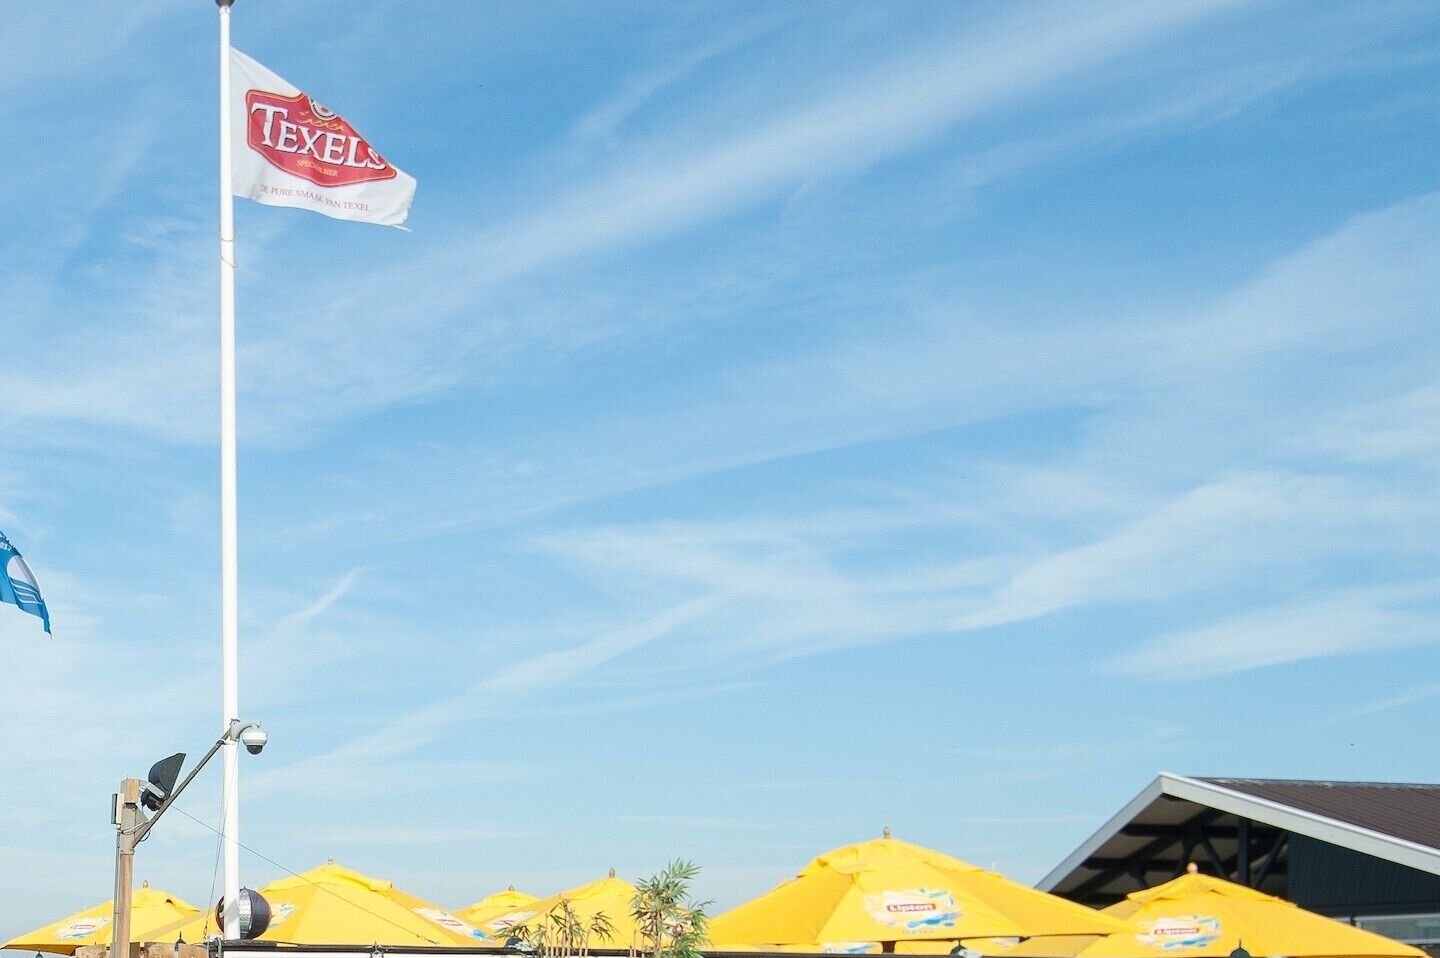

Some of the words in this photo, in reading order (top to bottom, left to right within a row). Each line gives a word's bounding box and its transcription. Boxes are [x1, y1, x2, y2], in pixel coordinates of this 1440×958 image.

[251, 102, 386, 170] TEXELS
[271, 187, 293, 196] PURE
[325, 196, 345, 209] VAN
[343, 201, 370, 213] TEXEL
[888, 903, 934, 912] Lipton
